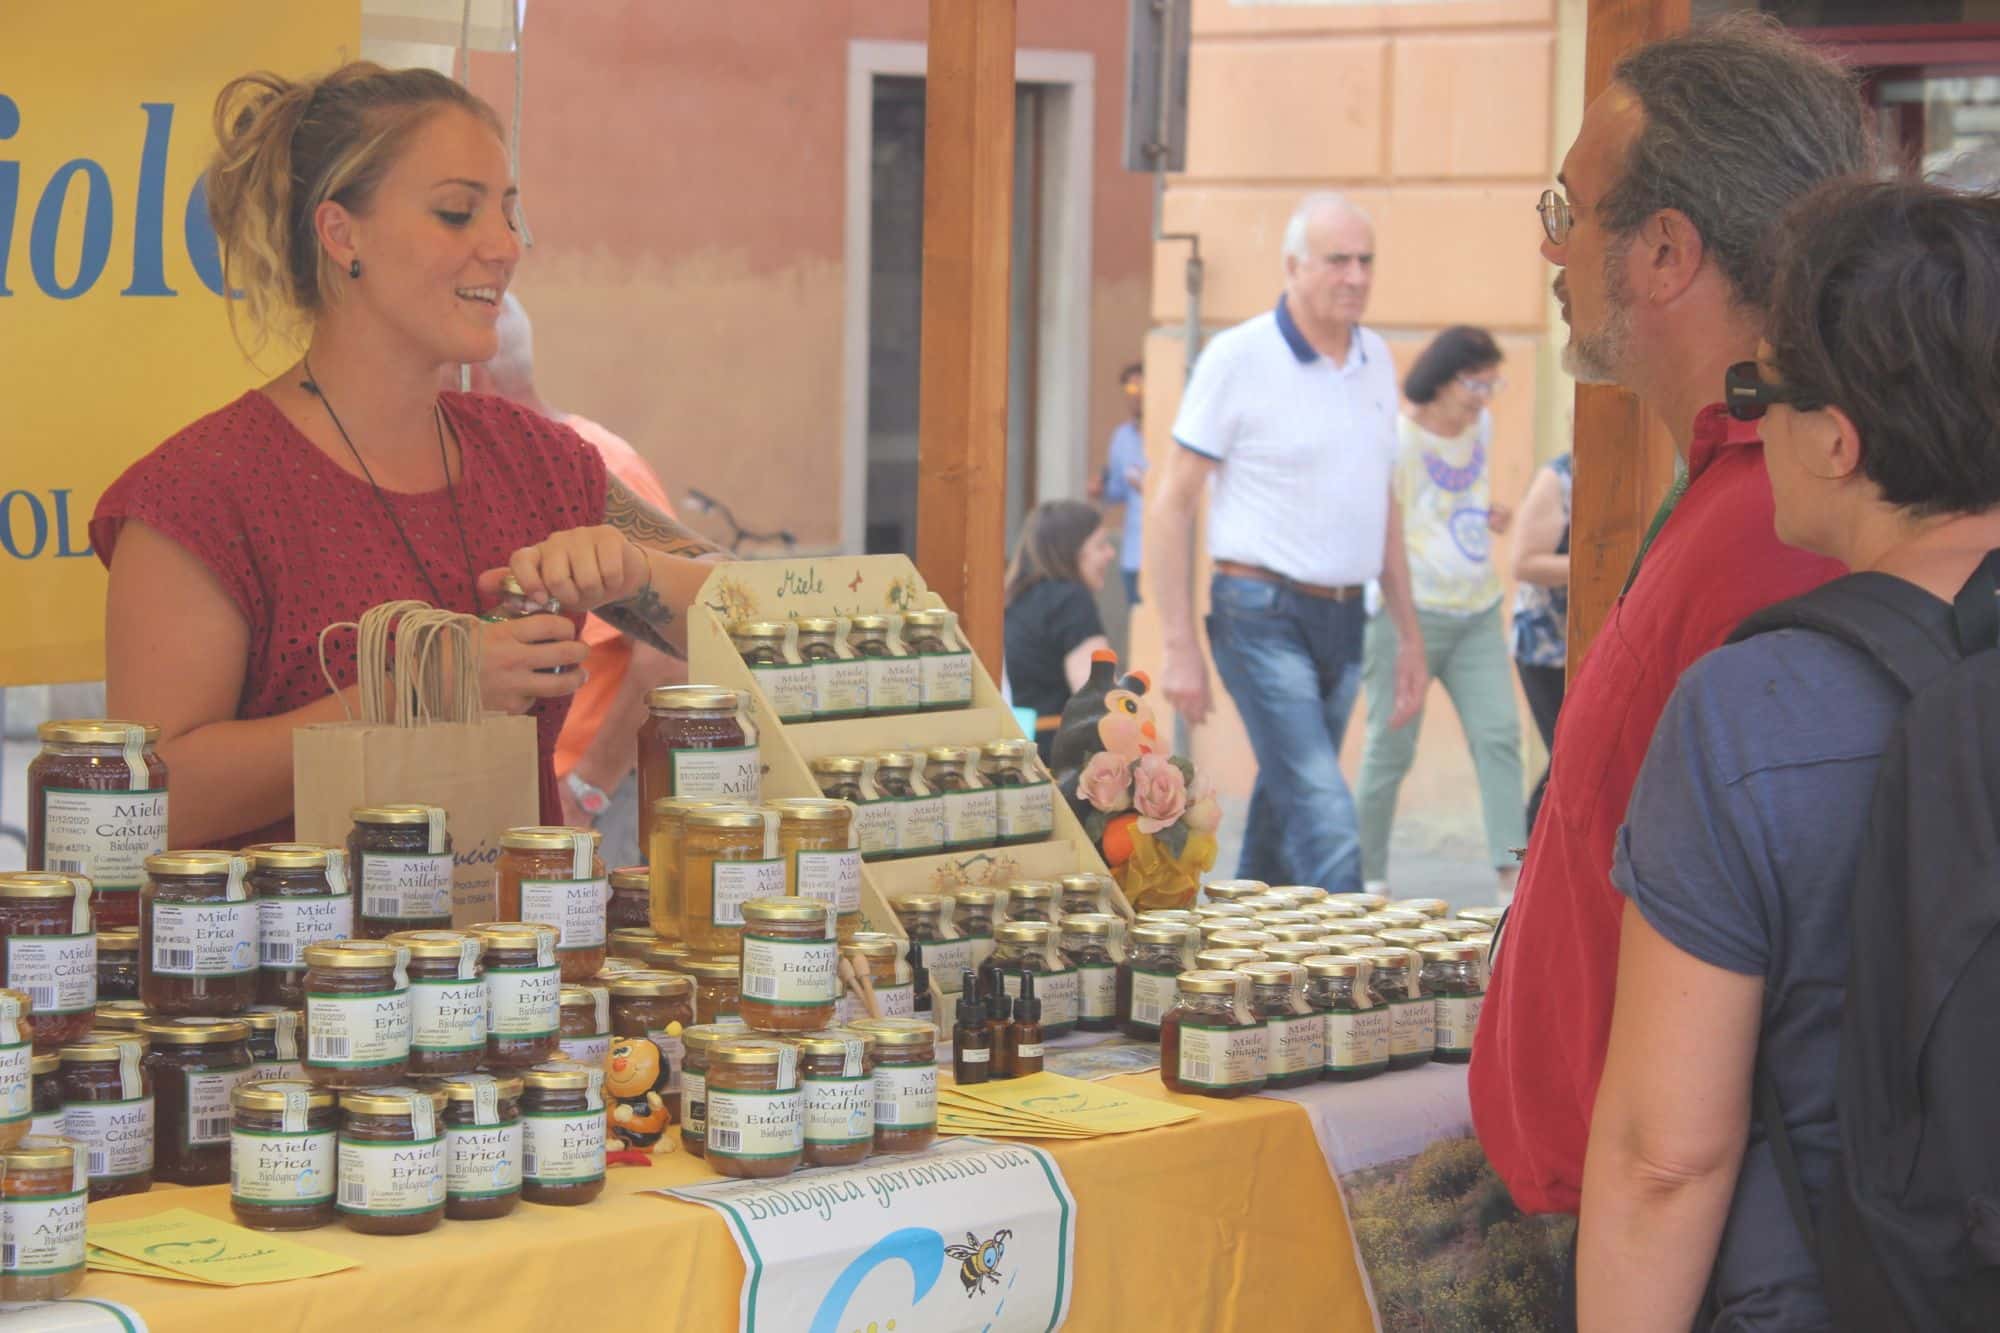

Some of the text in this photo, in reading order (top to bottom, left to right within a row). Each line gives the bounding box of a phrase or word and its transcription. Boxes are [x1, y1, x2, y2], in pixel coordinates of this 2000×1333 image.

[776, 566, 824, 598] Miele
[112, 798, 164, 818] Miele
[403, 860, 440, 872] Miele
[196, 907, 239, 923] Miele
[296, 901, 337, 916] Miele
[196, 926, 235, 940] Erica
[296, 921, 333, 934] Erica
[440, 985, 484, 1000] Miele
[439, 1004, 482, 1016] Erica
[0, 1052, 25, 1068] iele
[817, 1083, 865, 1097] Miele
[456, 1130, 510, 1145] Miele
[260, 1138, 319, 1153] Miele
[393, 1144, 440, 1162] Miele
[258, 1156, 312, 1170] Erica
[456, 1149, 506, 1162] Erica
[391, 1164, 439, 1179] Erica
